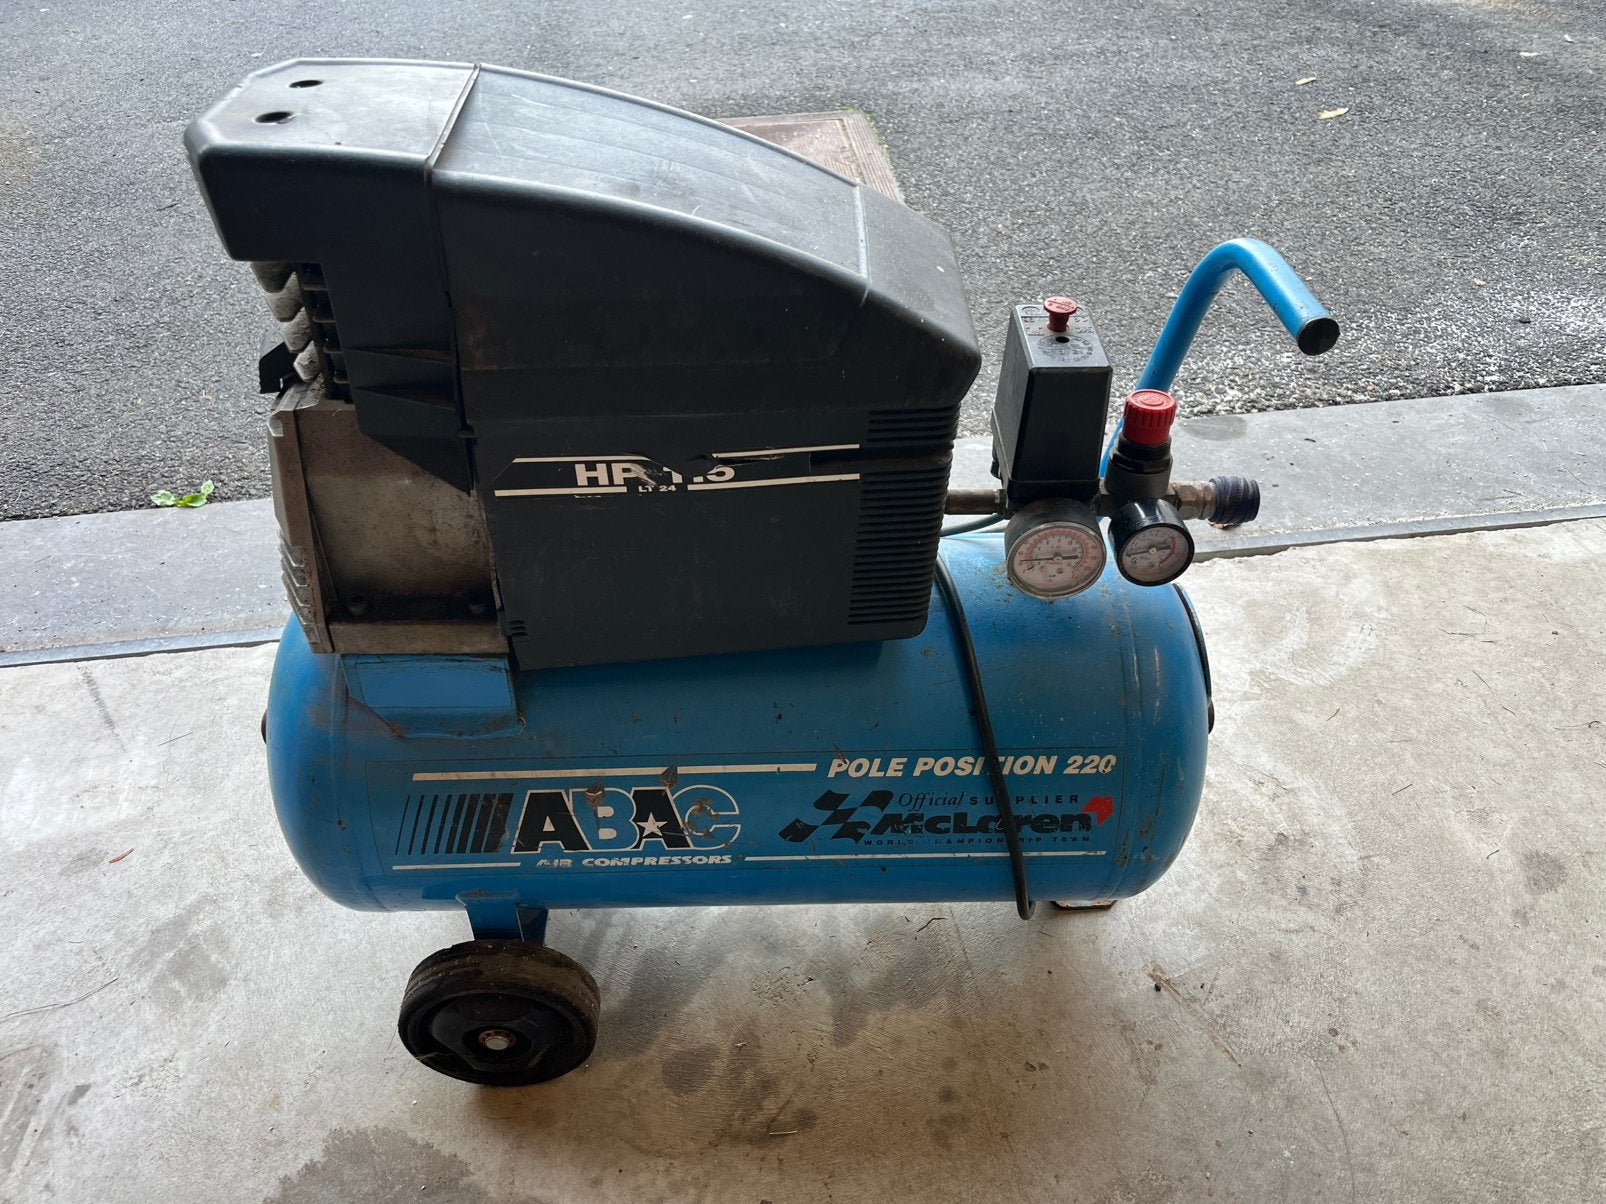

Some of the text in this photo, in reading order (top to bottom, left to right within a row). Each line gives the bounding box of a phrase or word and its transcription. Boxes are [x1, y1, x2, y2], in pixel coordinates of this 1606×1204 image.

[574, 462, 646, 486] HP
[637, 484, 677, 493] LT 24
[827, 757, 908, 778] POLE
[1063, 754, 1117, 775] 220
[898, 791, 1079, 811] Official SUPLIER
[510, 785, 741, 855] ABAC
[869, 811, 1093, 835] McLaren
[1052, 836, 1090, 844] TEAM
[536, 854, 733, 868] AIR COMPRESSORS
